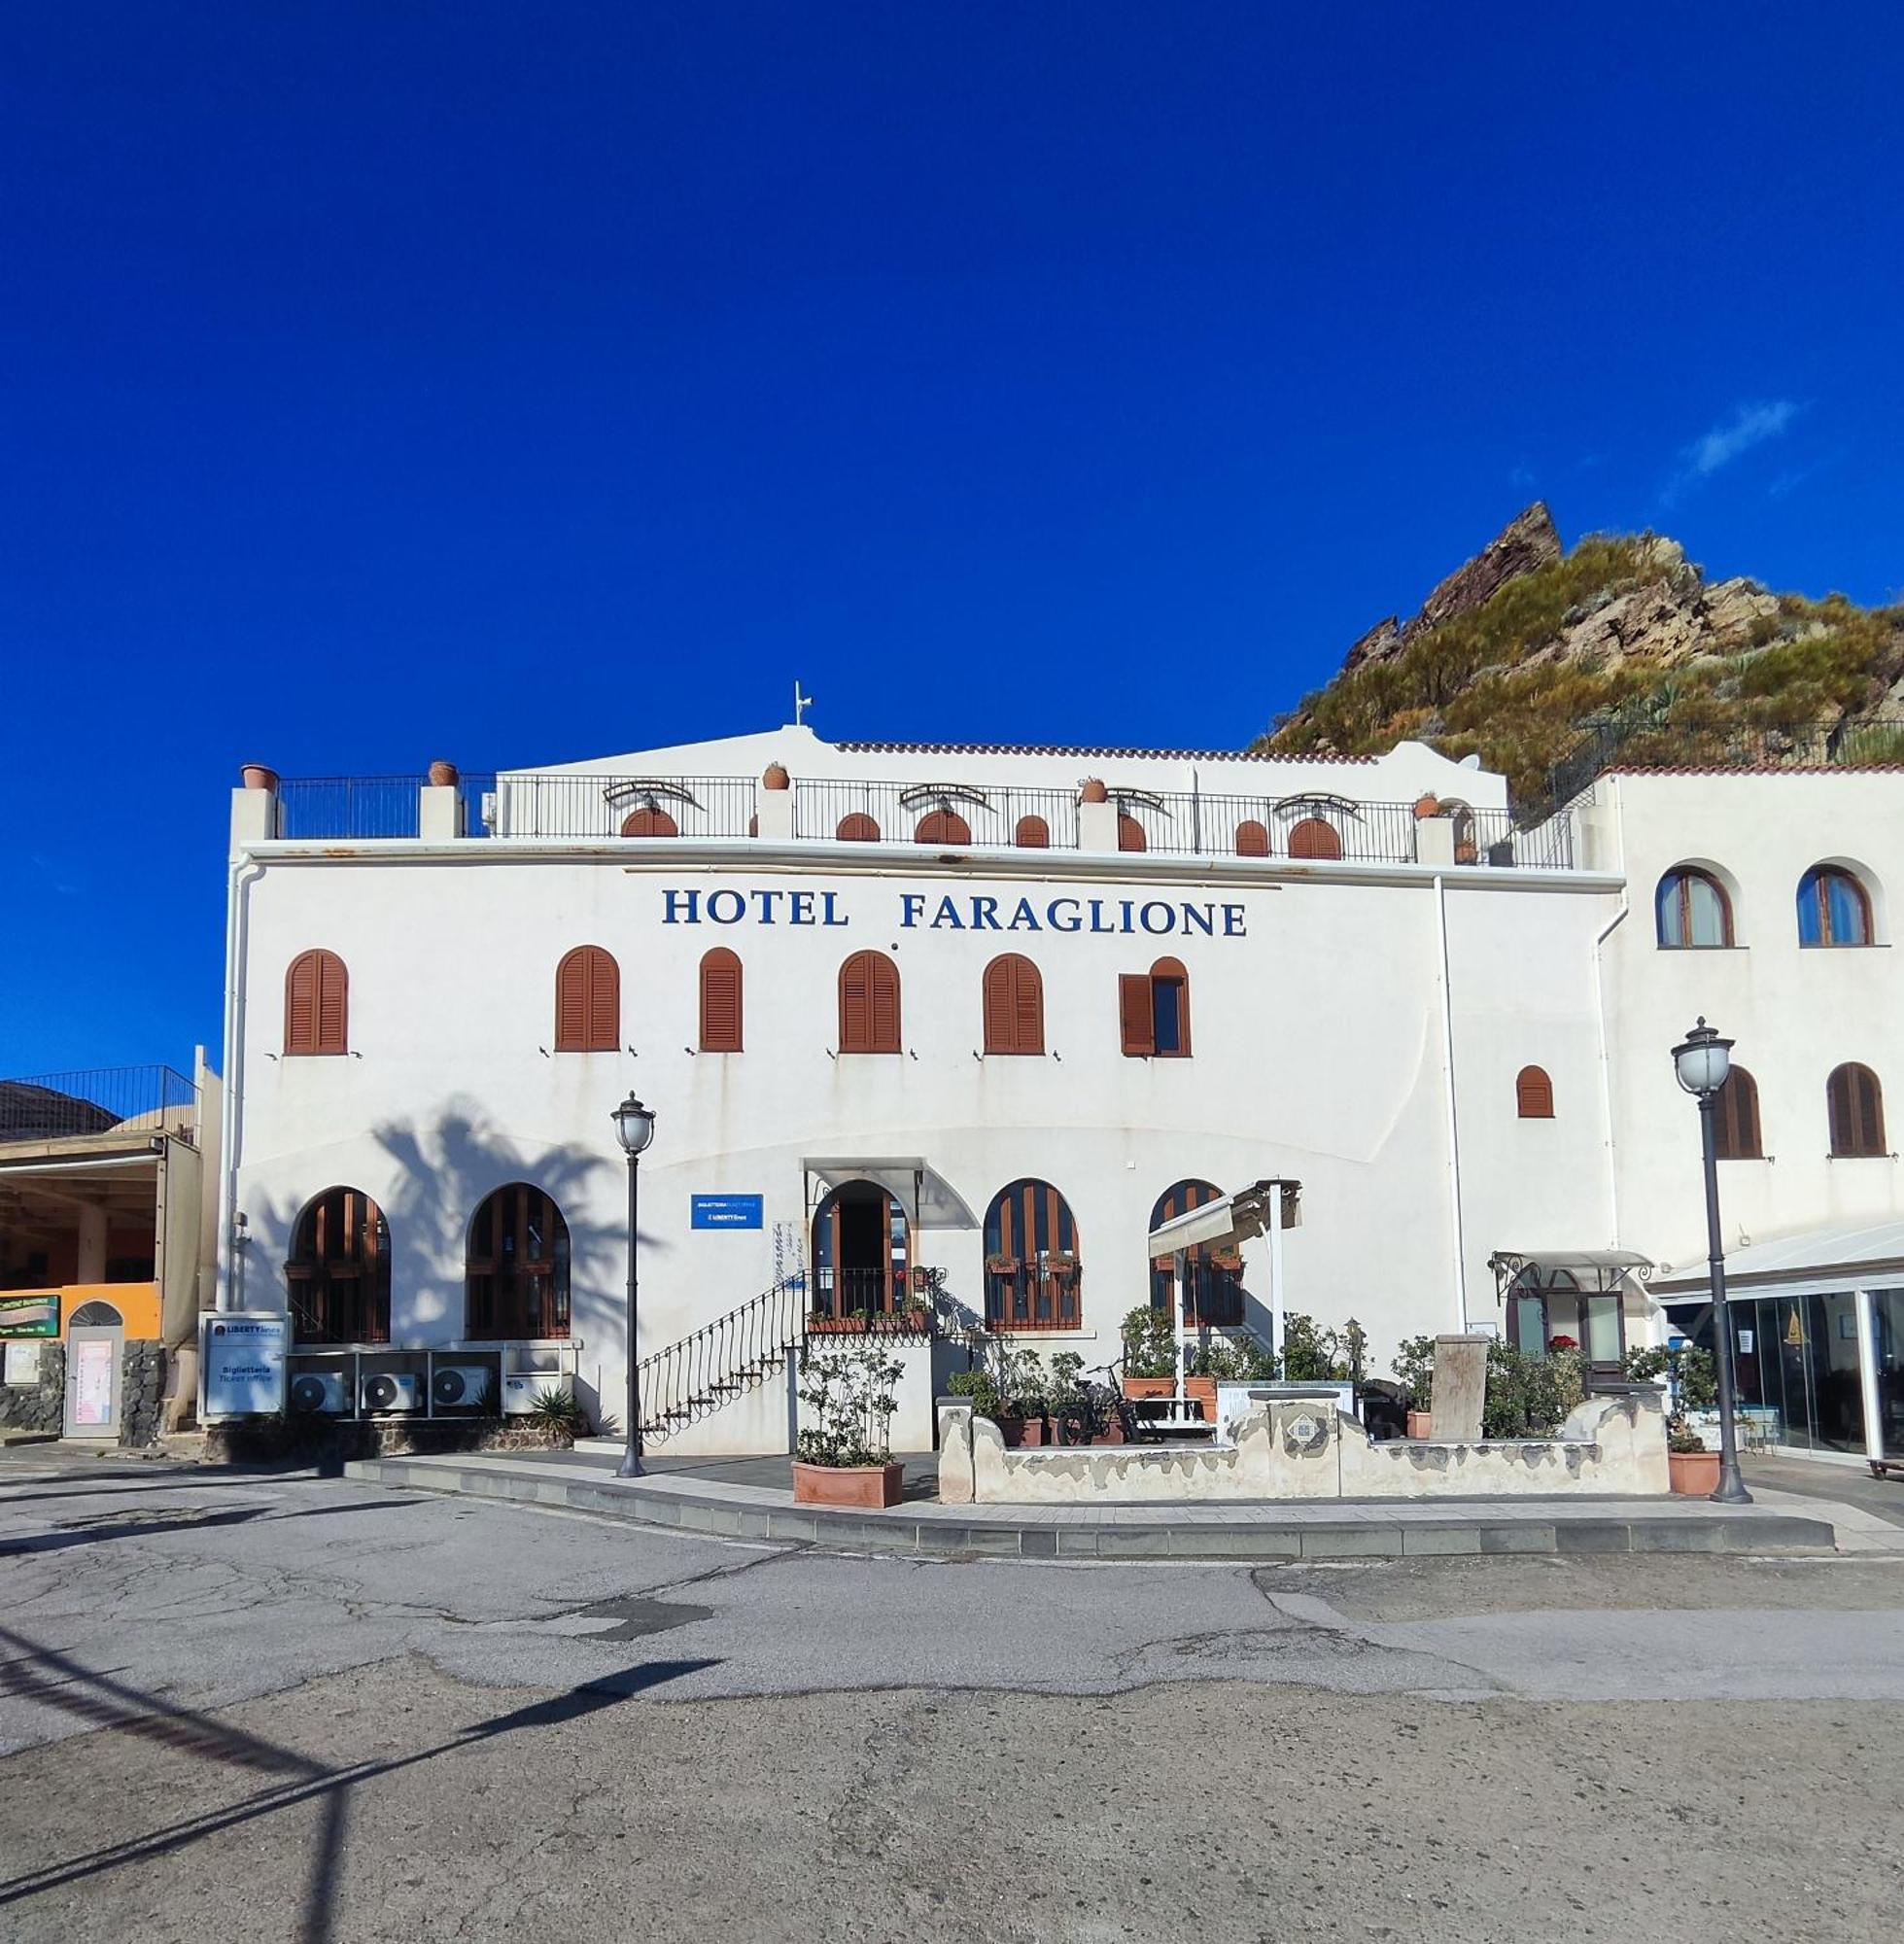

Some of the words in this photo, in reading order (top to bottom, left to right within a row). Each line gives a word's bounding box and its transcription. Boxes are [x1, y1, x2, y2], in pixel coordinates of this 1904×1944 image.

[661, 890, 849, 926] HOTEL
[899, 893, 1247, 937] FARAGLIONE
[223, 1365, 271, 1374] Biglietteria
